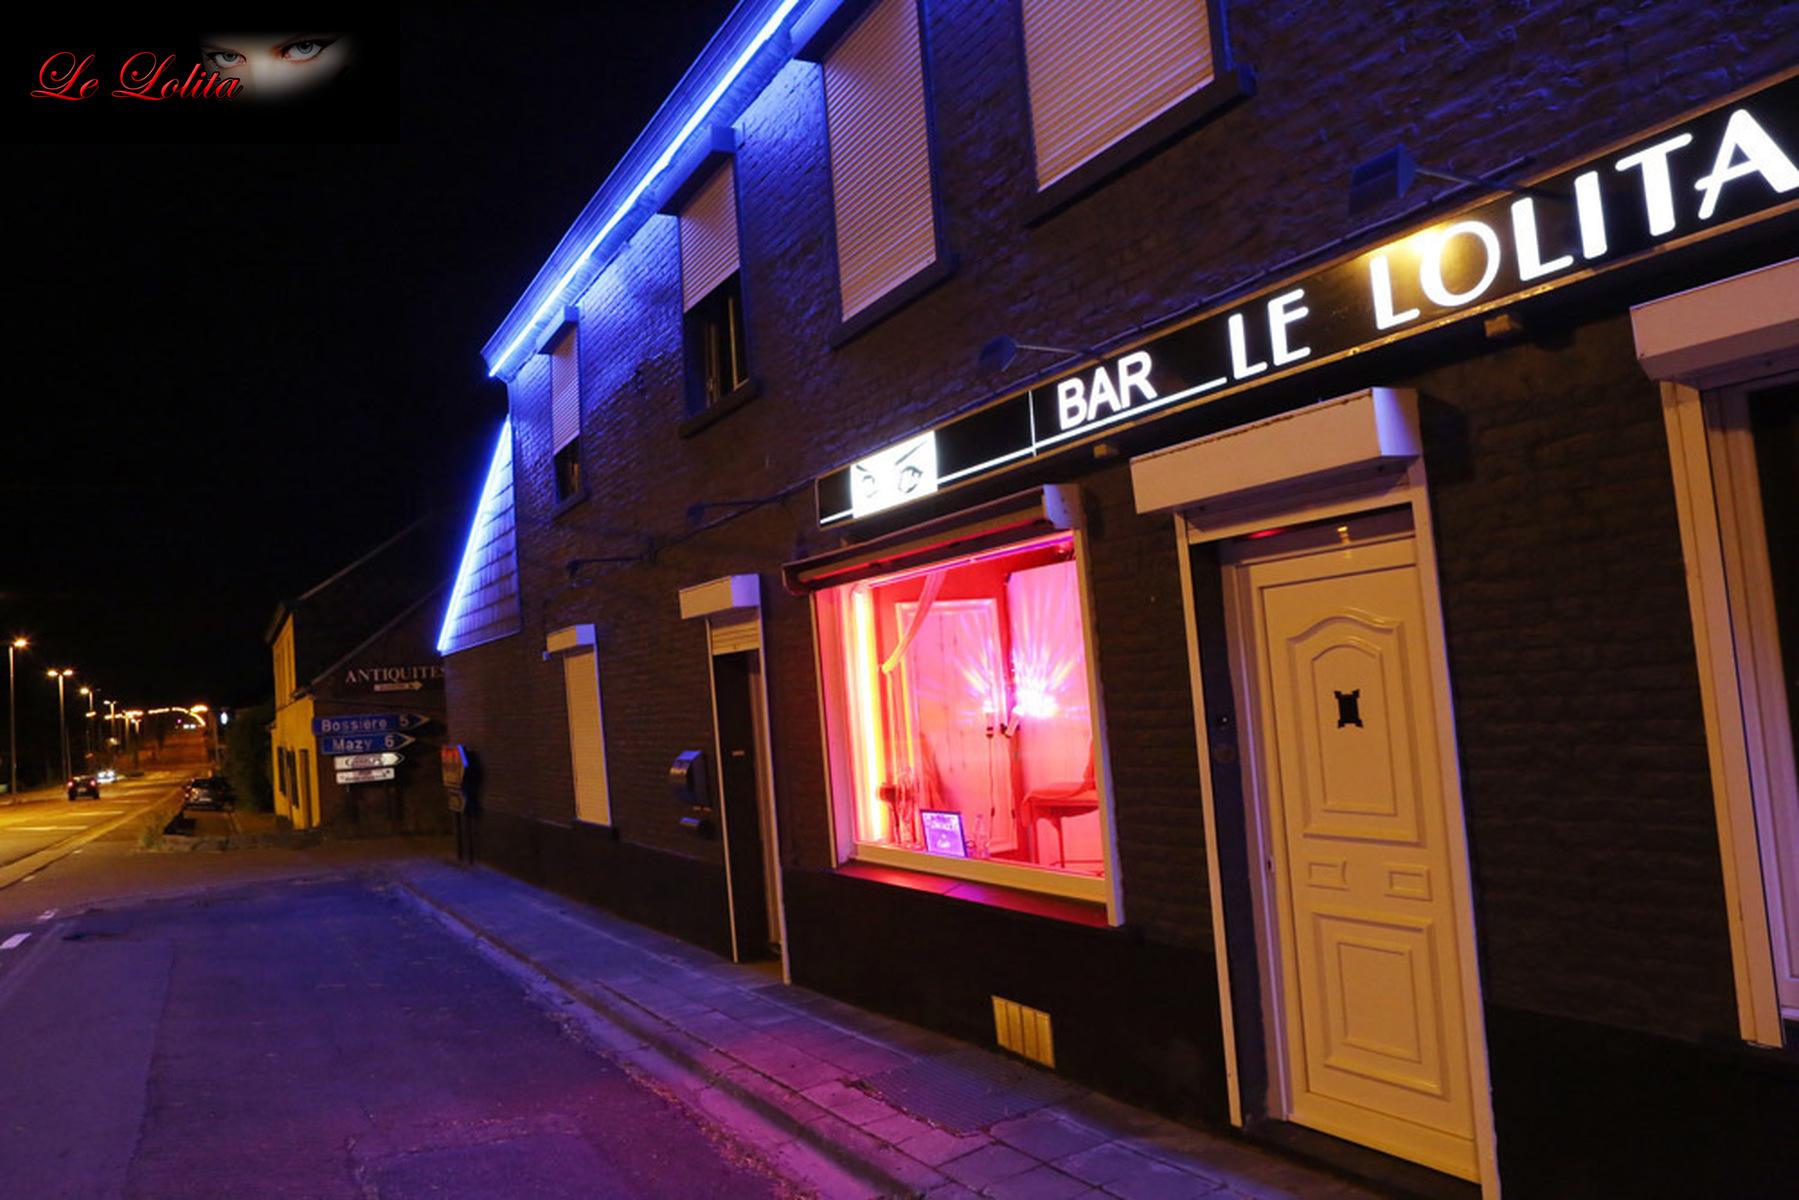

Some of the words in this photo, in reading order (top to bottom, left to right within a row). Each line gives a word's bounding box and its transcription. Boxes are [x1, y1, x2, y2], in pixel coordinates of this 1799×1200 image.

[1057, 350, 1158, 431] BAR
[1227, 287, 1312, 381] LE
[1368, 108, 1799, 331] LOLITA
[332, 736, 373, 751] Mazy
[384, 735, 395, 748] 6
